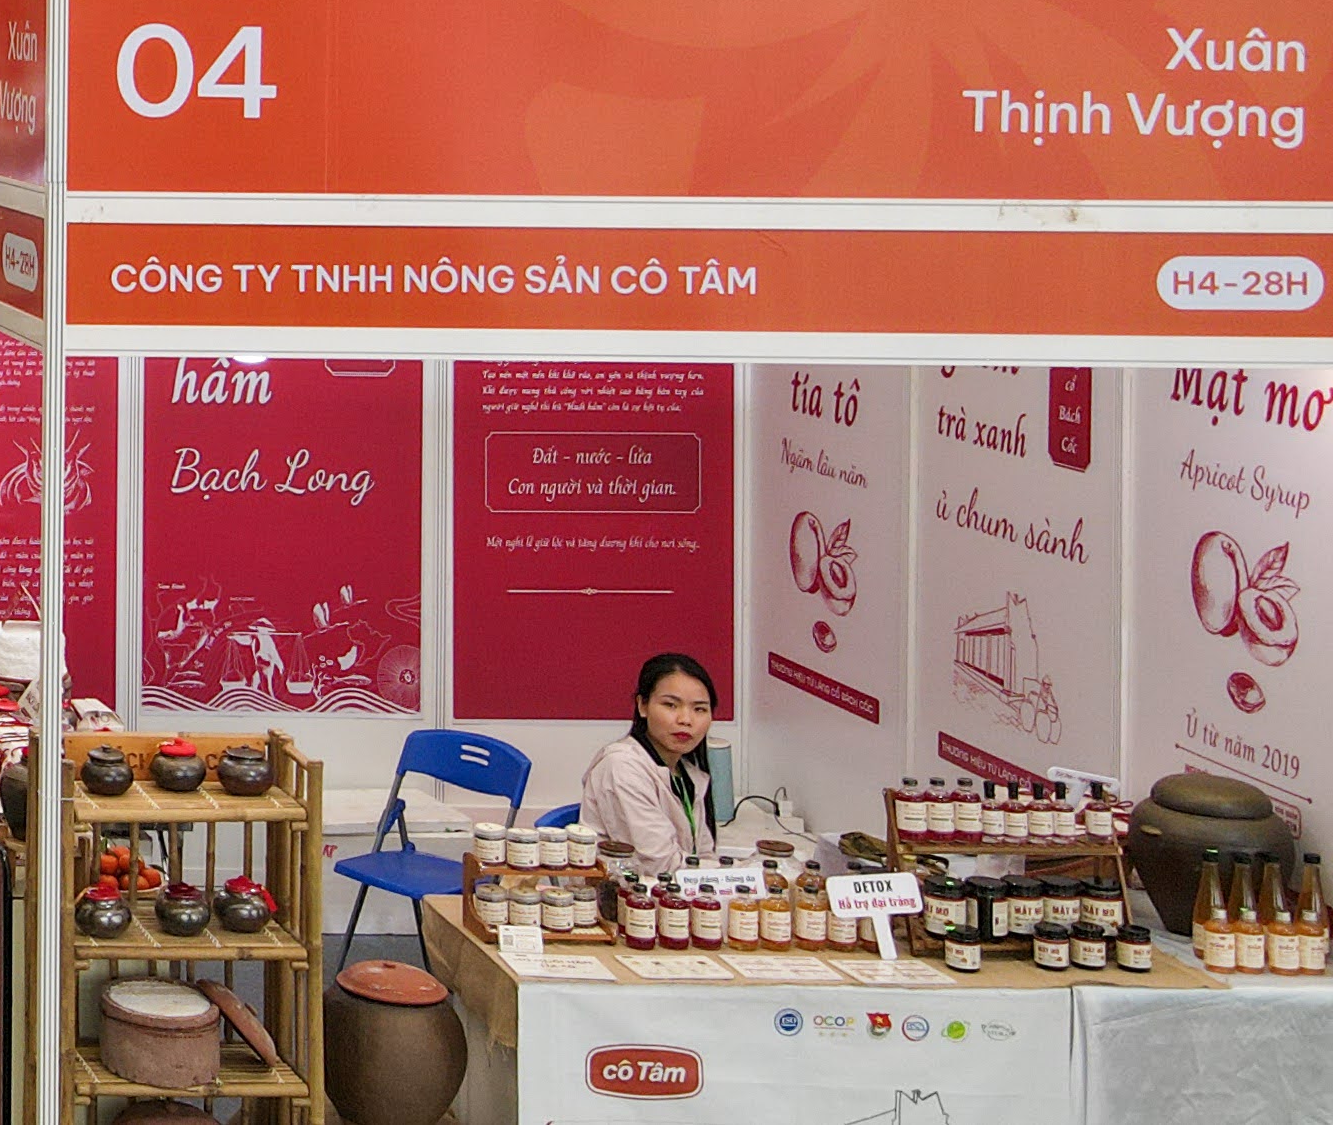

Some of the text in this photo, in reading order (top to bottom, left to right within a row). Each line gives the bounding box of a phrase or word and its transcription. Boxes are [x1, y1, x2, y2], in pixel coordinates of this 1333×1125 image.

[7, 19, 38, 62] Xuân
[1165, 27, 1306, 73] Xuân
[115, 22, 278, 120] 04
[962, 88, 1306, 150] Thịnh Vượng
[110, 255, 758, 297] CÔNG TY TNHH NÔNG SẢN CÔ TÂM
[1171, 270, 1309, 297] H4-28H
[171, 357, 272, 405] hâm
[790, 371, 860, 427] tía tô
[1169, 369, 1246, 426] Mật
[936, 403, 1028, 459] trà xanh
[170, 447, 375, 507] Bạch Long
[531, 446, 558, 466] Đất
[575, 446, 613, 466] nước
[507, 477, 535, 496] Con
[538, 477, 582, 502] người
[585, 478, 605, 496] và
[608, 475, 638, 496] thời
[1180, 448, 1311, 516] Apricot Syrup
[936, 488, 1090, 565] ủ chum sành
[1185, 712, 1301, 779] Ủ từ năm 2019
[853, 879, 893, 895] DETOX
[813, 1014, 855, 1028] OCOP
[602, 1059, 687, 1084] cô Tâm
